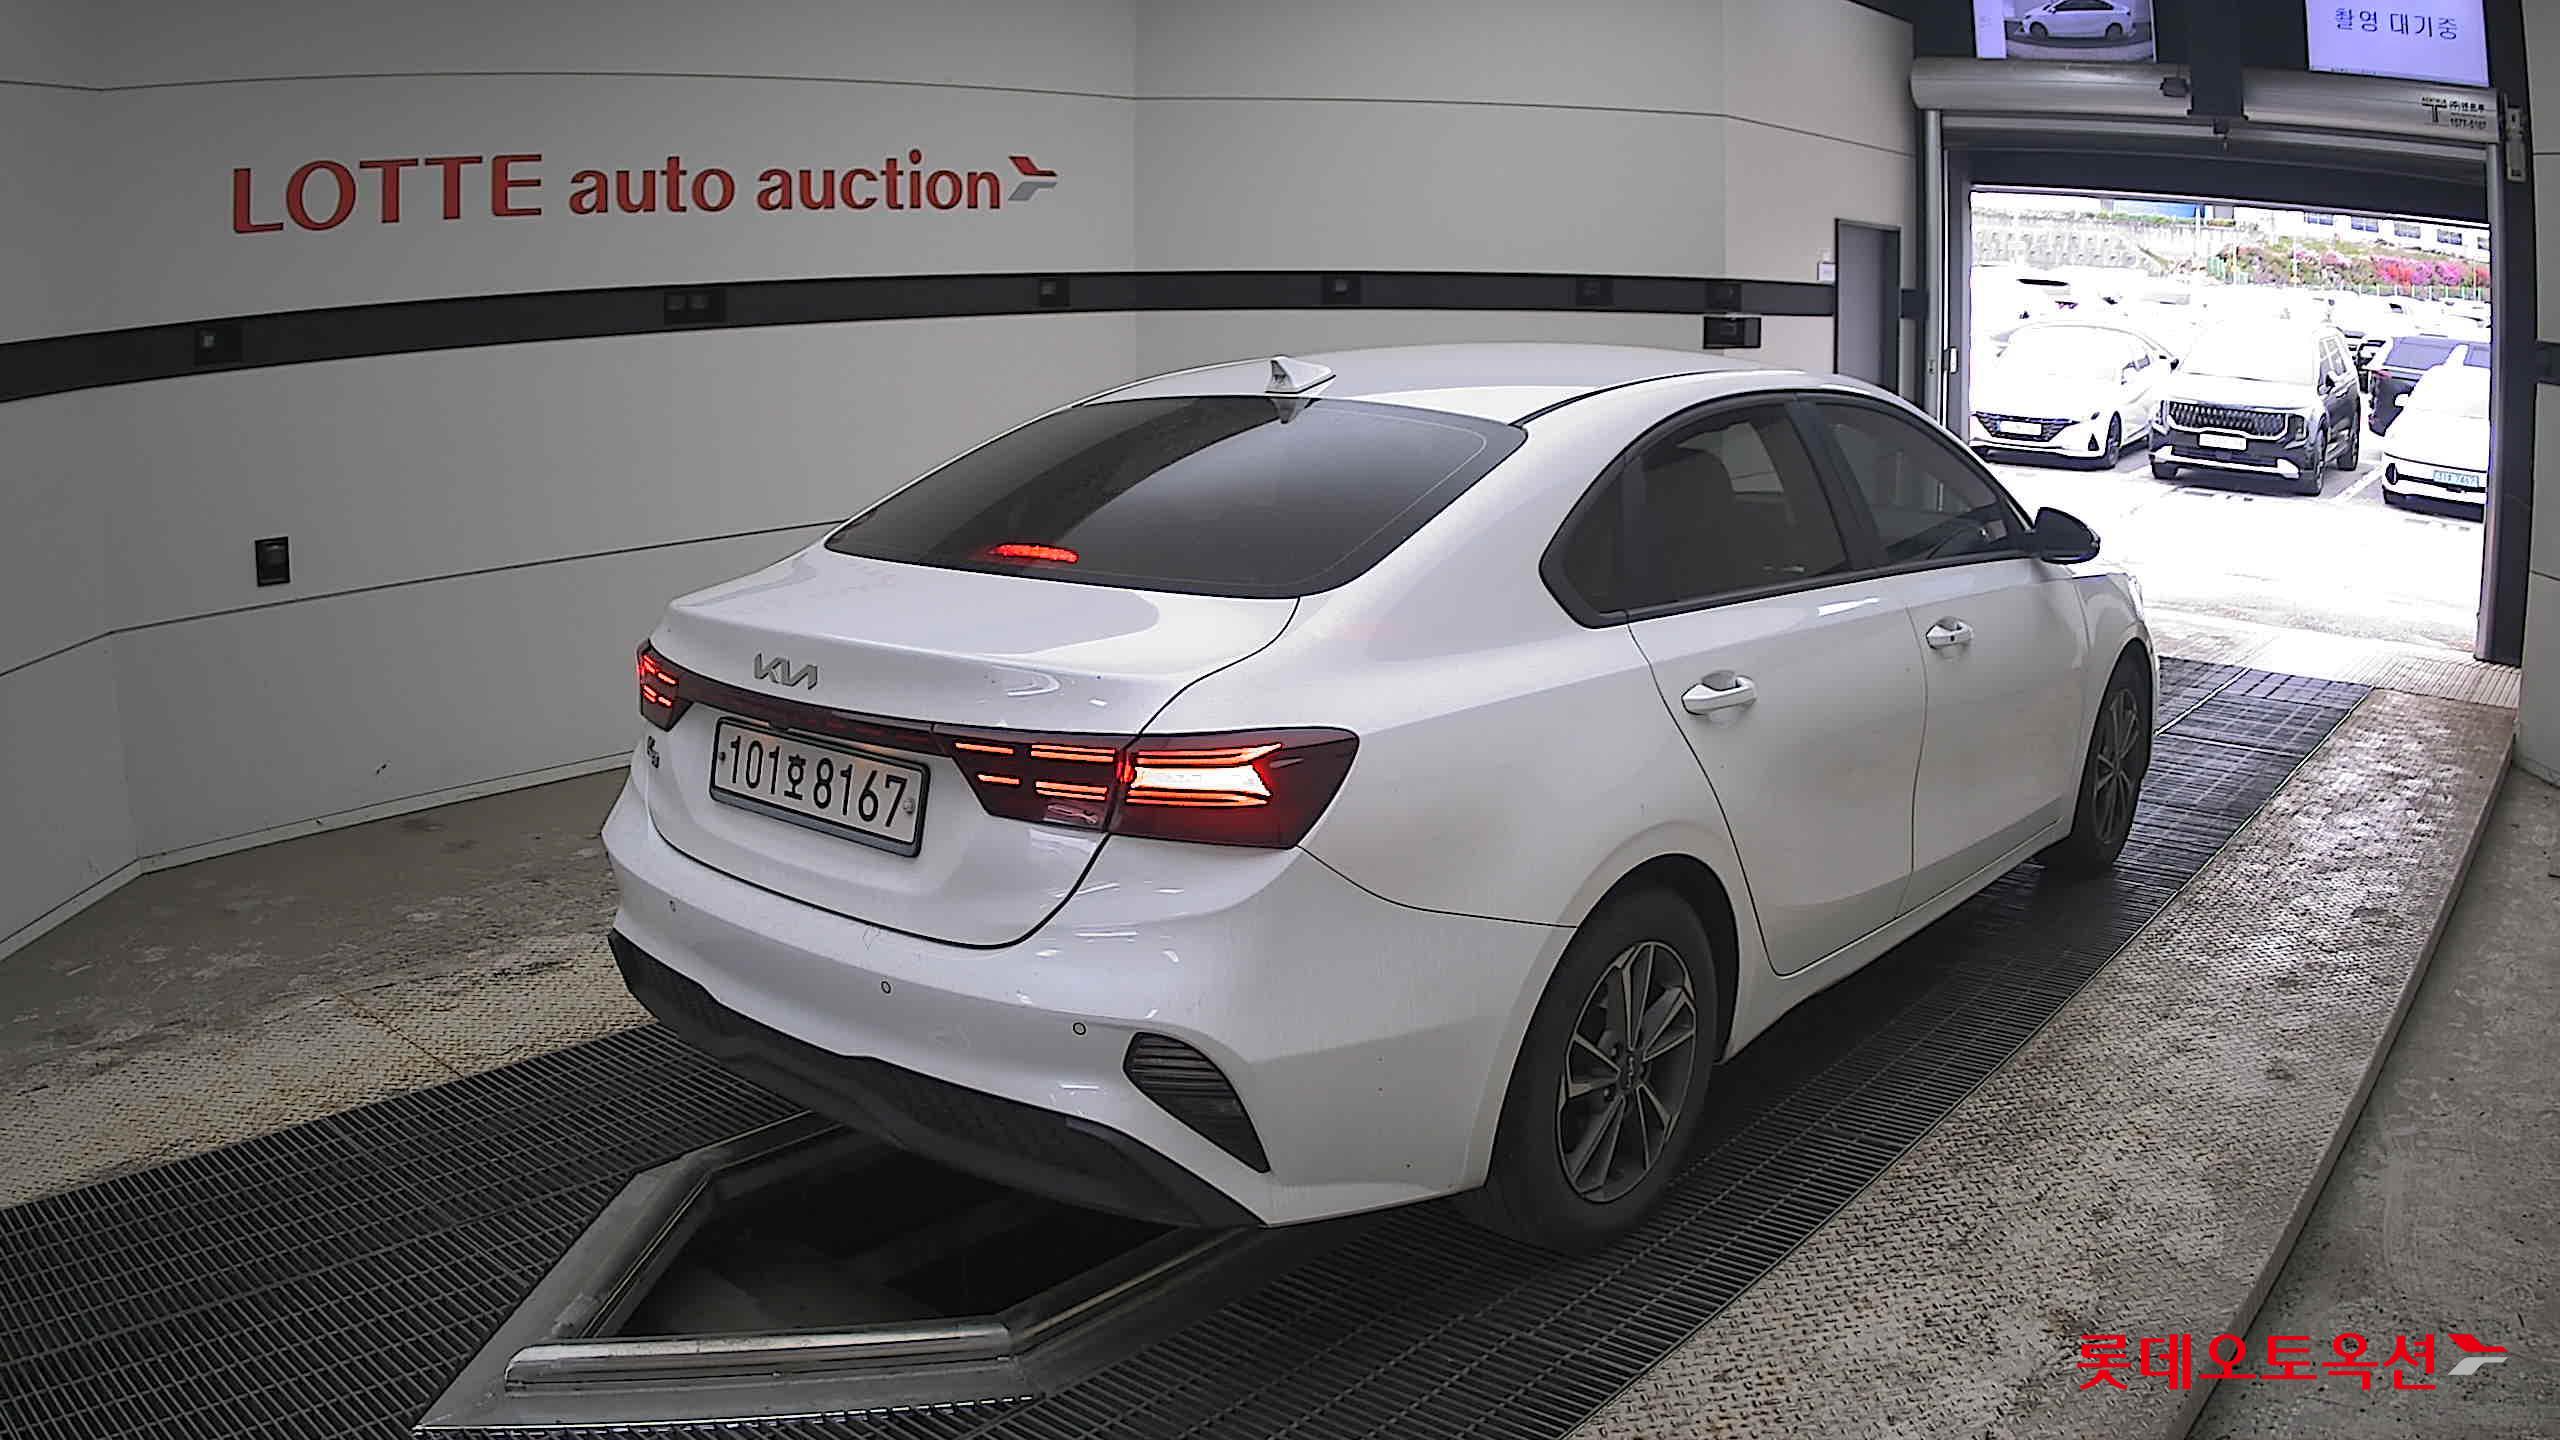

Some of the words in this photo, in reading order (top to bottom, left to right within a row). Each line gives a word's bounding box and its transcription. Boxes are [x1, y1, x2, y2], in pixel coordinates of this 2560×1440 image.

[2389, 12, 2458, 41] 대기중
[233, 153, 542, 234] LOTTE
[568, 156, 736, 215] auto
[755, 148, 1000, 211] auction
[729, 734, 908, 828] 101호8167
